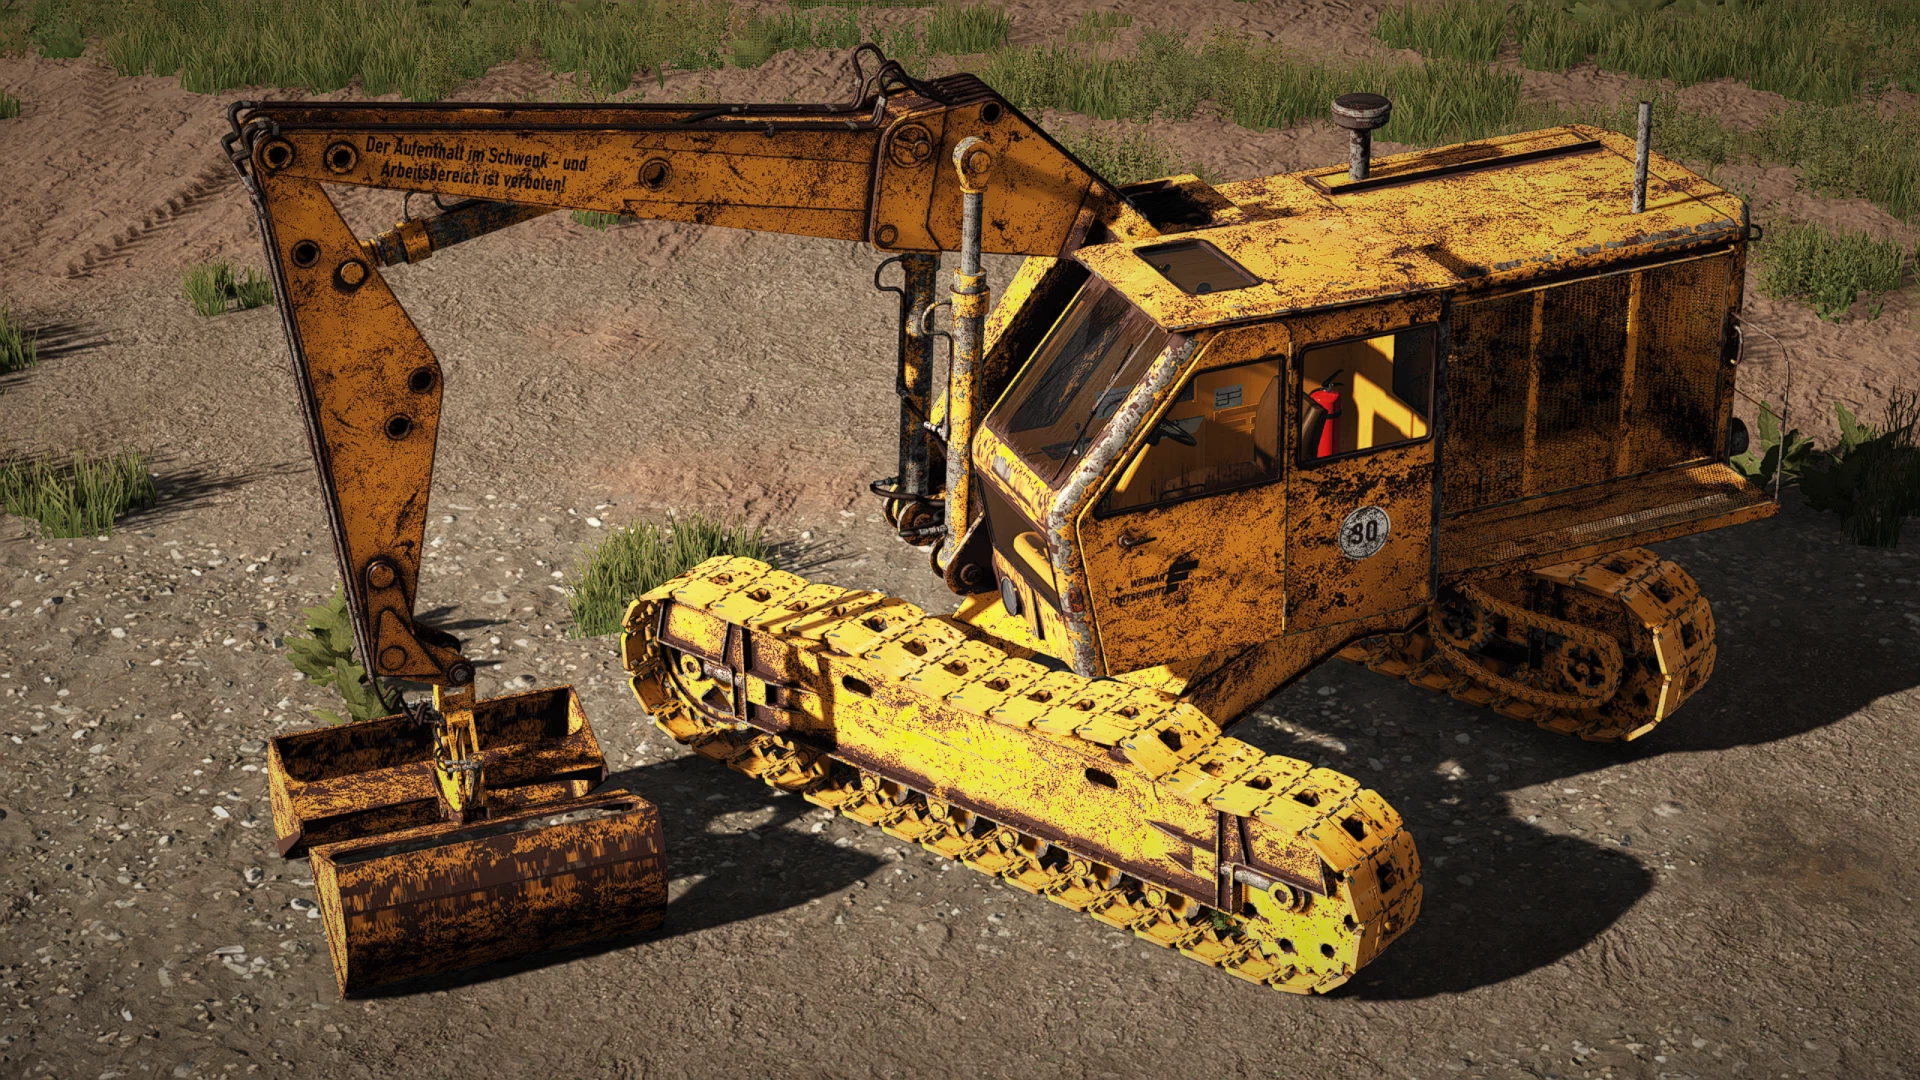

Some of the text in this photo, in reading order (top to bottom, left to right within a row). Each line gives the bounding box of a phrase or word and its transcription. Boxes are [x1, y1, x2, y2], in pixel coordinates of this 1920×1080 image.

[365, 135, 391, 154] Der
[393, 139, 465, 162] Aufenthalt
[466, 147, 486, 163] im
[489, 147, 549, 169] Schwenk
[563, 156, 588, 172] und
[380, 160, 567, 193] Arbeitsbereich ist verboten!
[1130, 573, 1166, 589] WEIMAR
